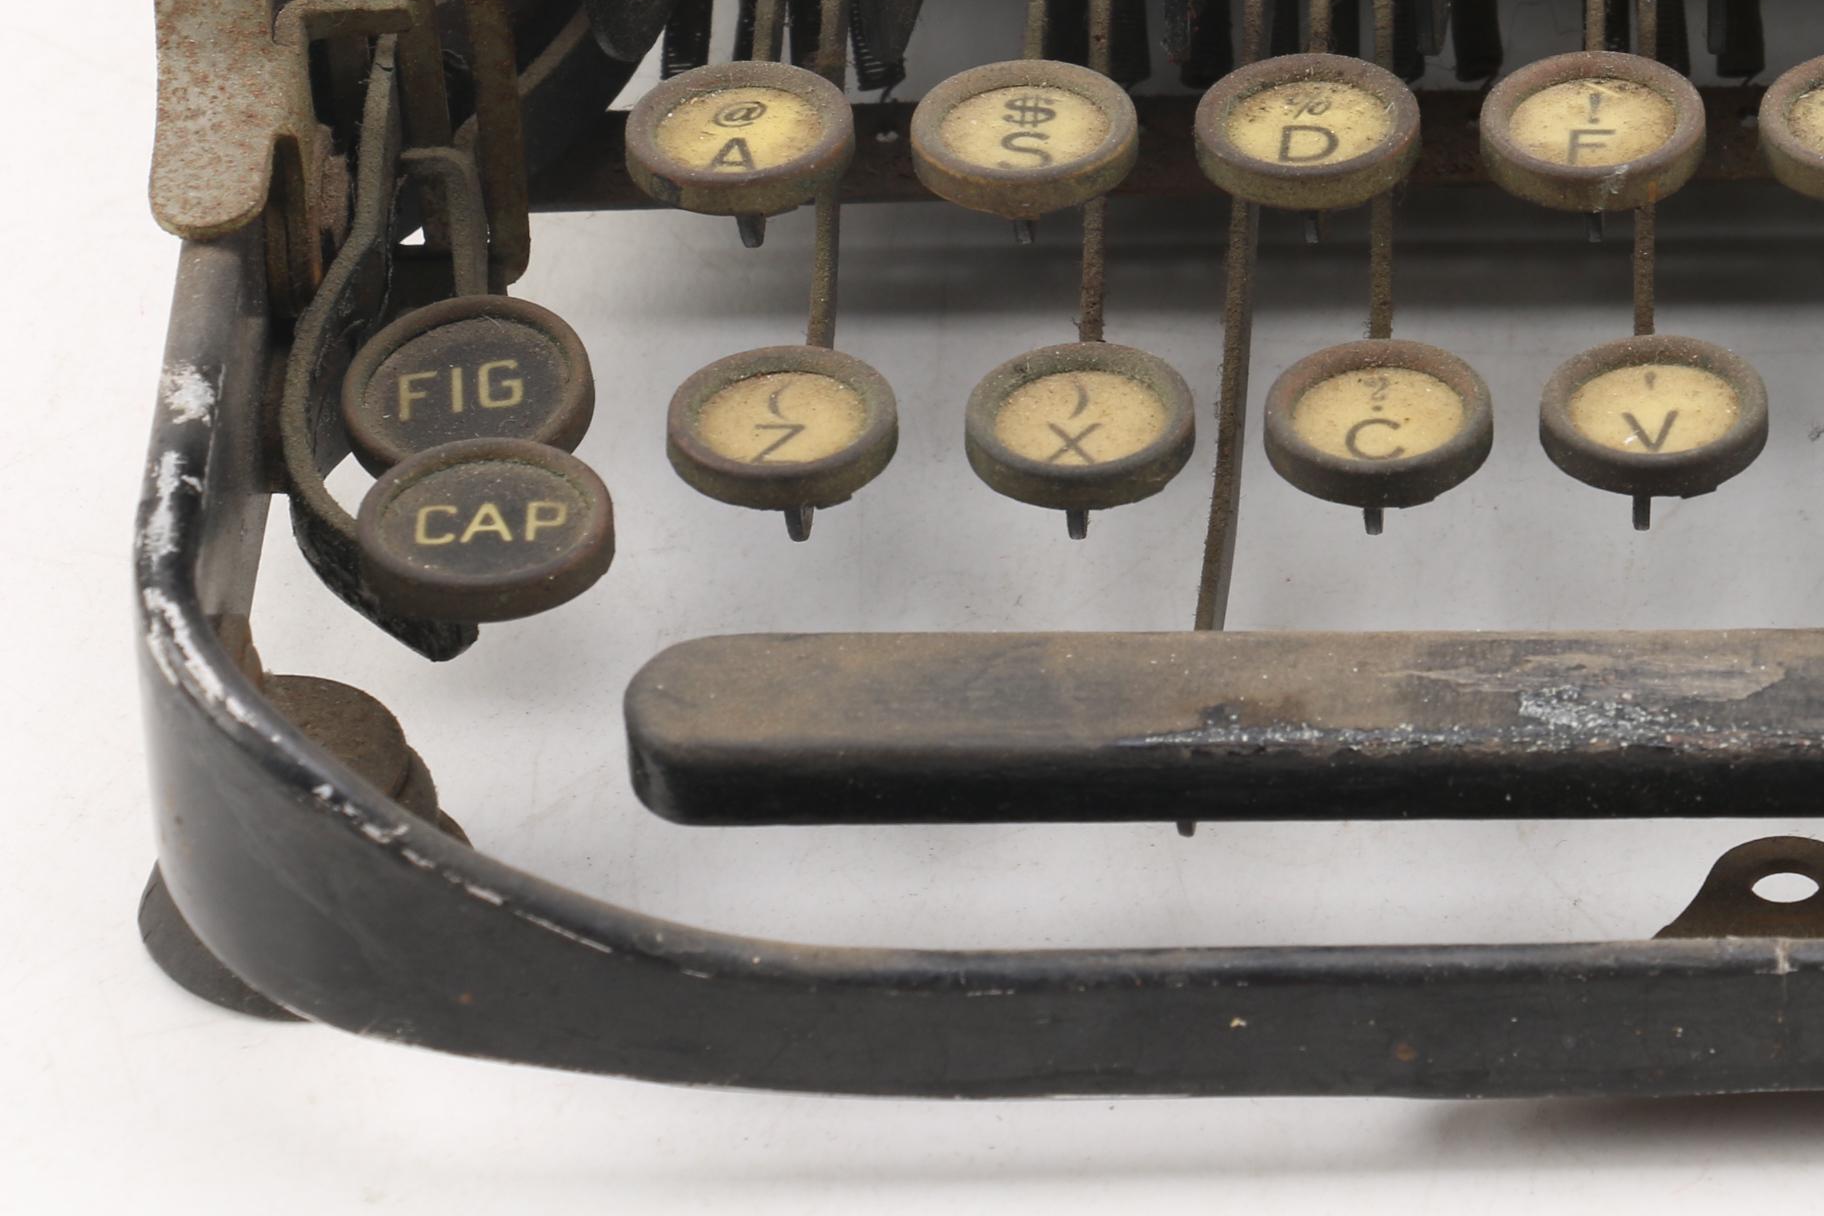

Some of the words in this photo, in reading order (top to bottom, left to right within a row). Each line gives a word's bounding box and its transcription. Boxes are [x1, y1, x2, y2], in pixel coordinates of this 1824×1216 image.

[712, 100, 767, 128] @
[1001, 94, 1056, 128] $
[709, 137, 756, 171] A
[997, 132, 1051, 169] S
[1278, 125, 1339, 164] D
[398, 360, 524, 422] FIG
[1047, 423, 1101, 463] X
[1345, 418, 1404, 460] C
[1622, 410, 1678, 452] V
[415, 501, 568, 546] CAP
